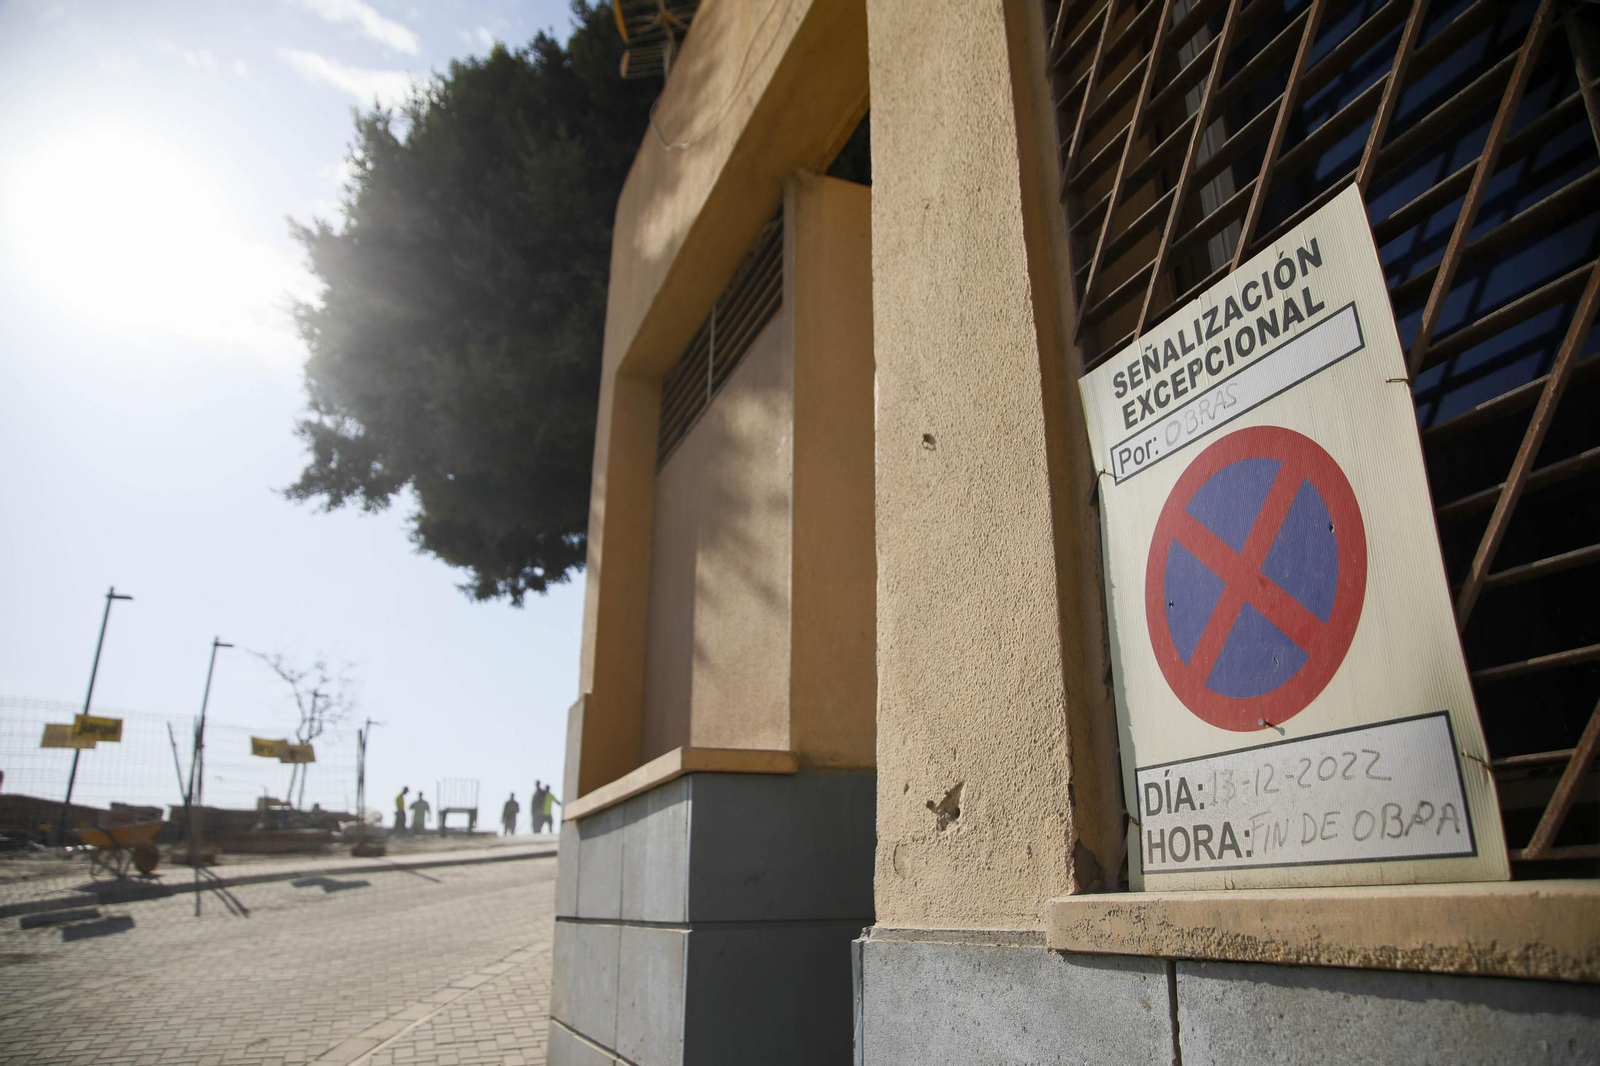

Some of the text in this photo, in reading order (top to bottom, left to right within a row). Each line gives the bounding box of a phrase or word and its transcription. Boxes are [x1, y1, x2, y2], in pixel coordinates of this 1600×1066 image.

[1112, 237, 1323, 399] SEÑALIZACIÓN
[1121, 286, 1325, 430] EXCEPCIONAL
[1118, 382, 1239, 474] Por: OBRAS
[1143, 769, 1205, 817] DÍA:
[1147, 821, 1252, 865] HORA:
[1249, 810, 1290, 855] FIN
[1301, 811, 1341, 846] DE
